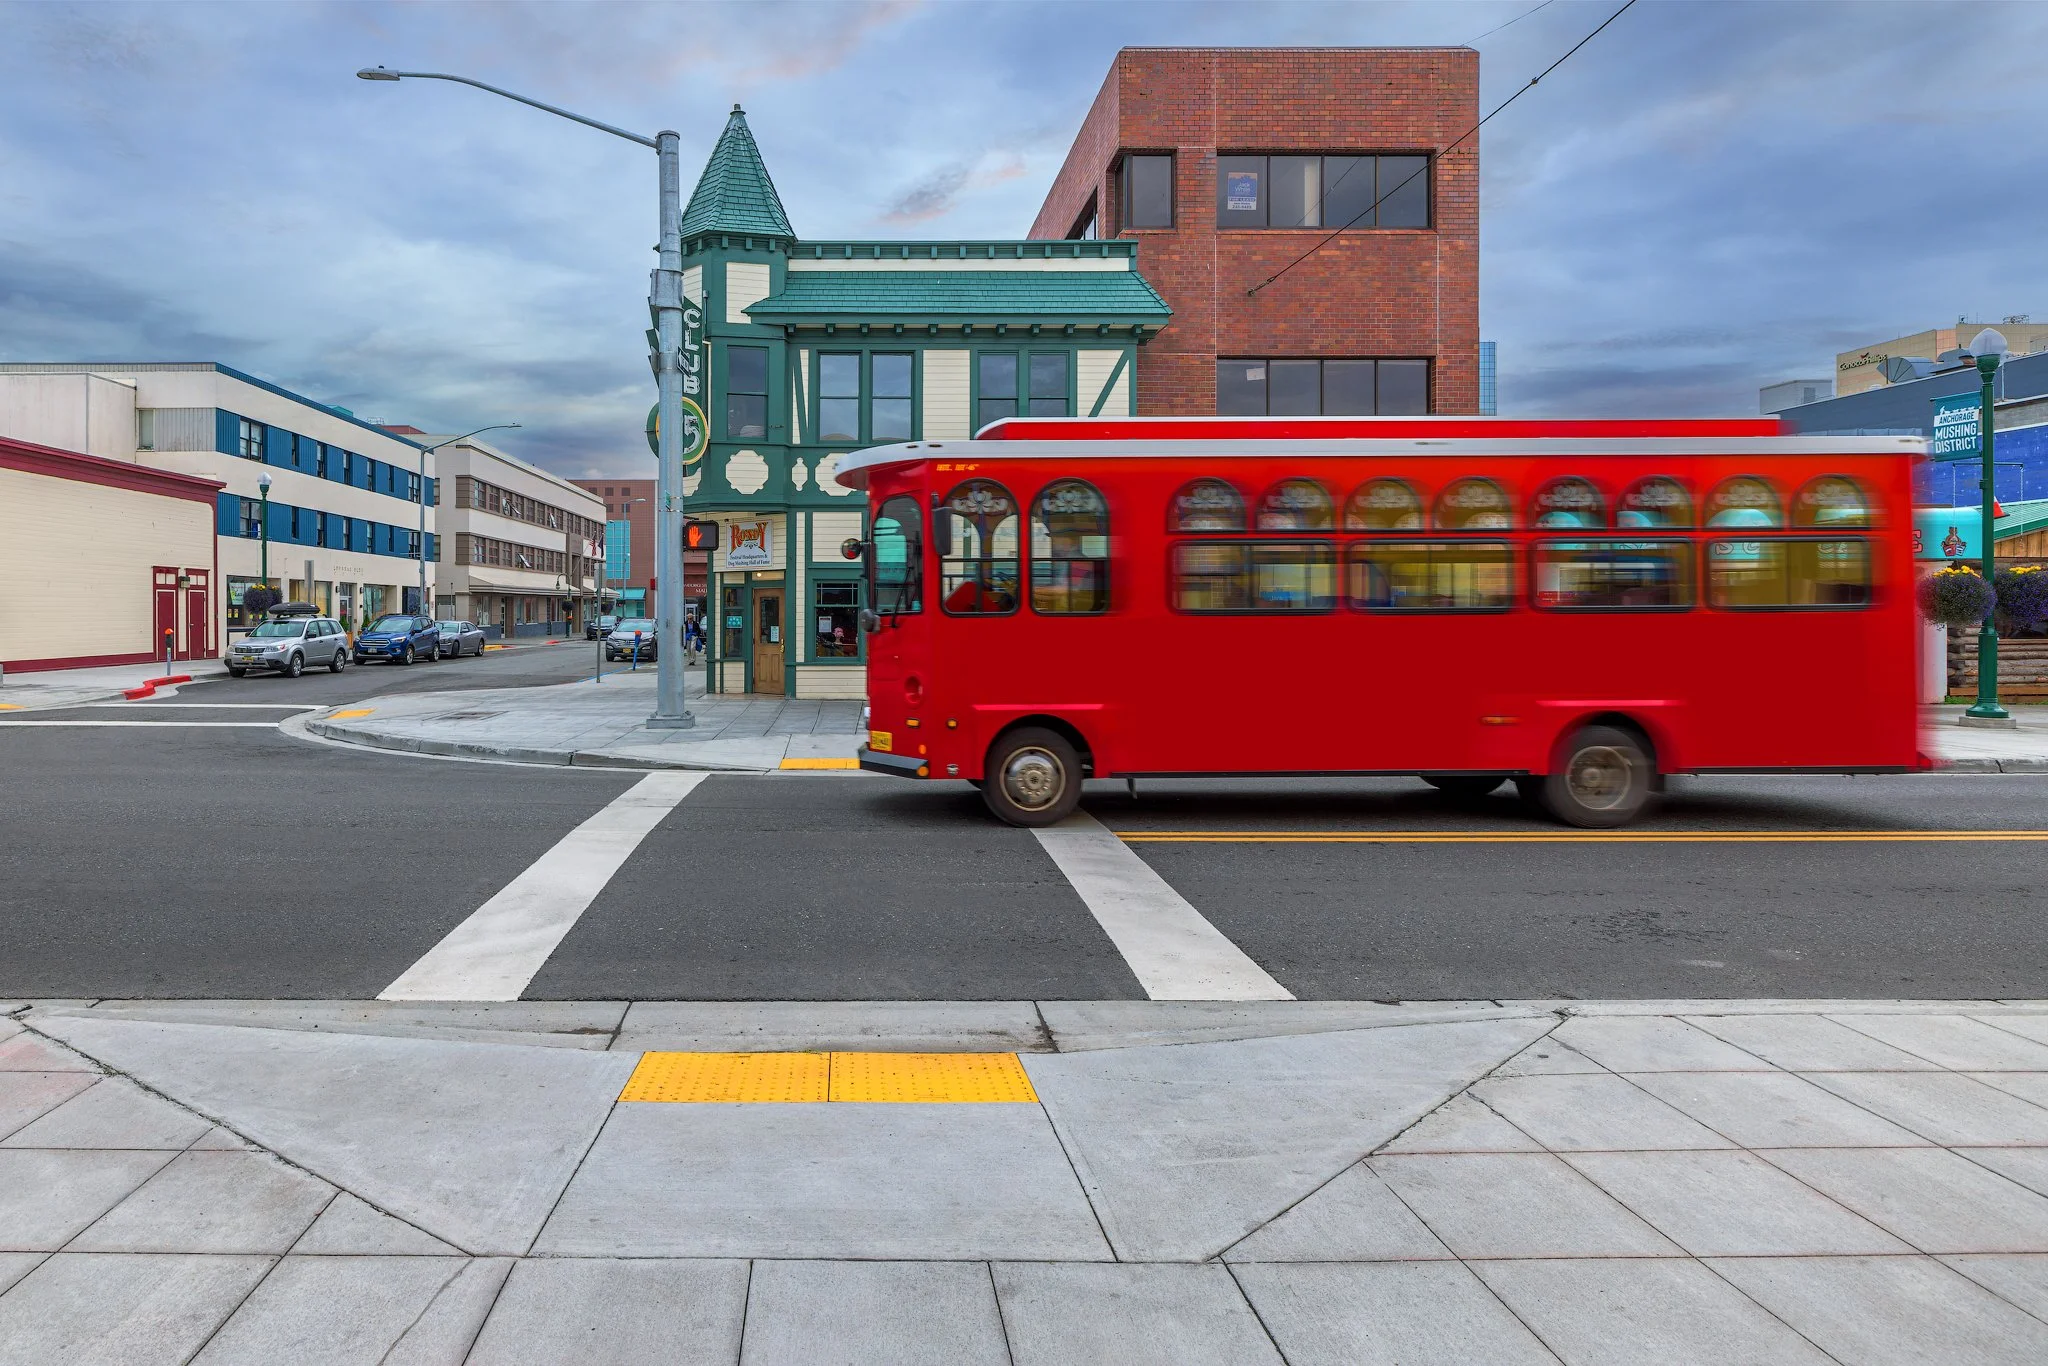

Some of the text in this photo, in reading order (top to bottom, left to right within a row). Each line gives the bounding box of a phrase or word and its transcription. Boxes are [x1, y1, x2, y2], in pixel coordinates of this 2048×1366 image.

[1839, 353, 1888, 370] ConocoPhillips
[1939, 411, 1975, 424] ANCHORAGE
[1935, 423, 1977, 440] MUSHING
[1935, 437, 1977, 454] DISTRICT
